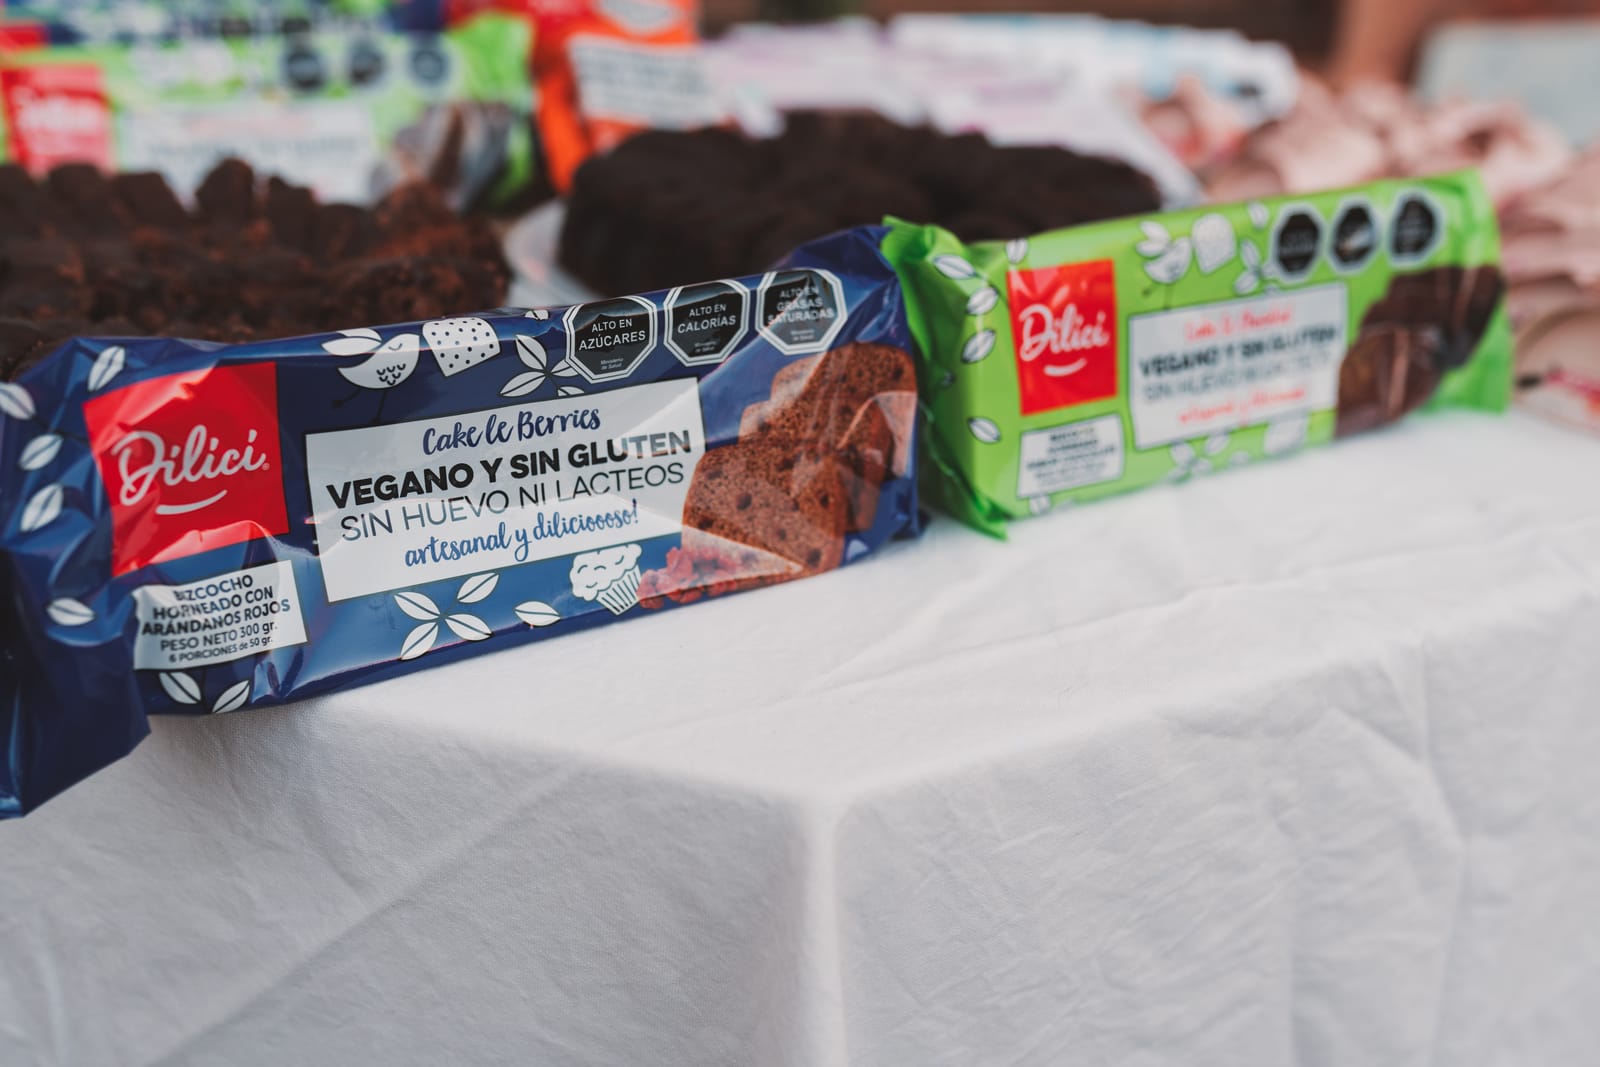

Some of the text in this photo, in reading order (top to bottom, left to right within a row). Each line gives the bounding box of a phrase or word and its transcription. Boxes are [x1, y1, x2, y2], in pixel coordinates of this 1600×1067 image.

[780, 286, 819, 298] ALTO EN
[591, 318, 633, 333] ALTO EN
[677, 314, 736, 334] CALORÍAS
[689, 304, 726, 317] ALTO EN
[578, 331, 646, 351] AZÚCARES
[1019, 303, 1109, 361] Dilici
[422, 408, 601, 455] Cake le Berries
[111, 425, 266, 505] Dilici
[326, 430, 691, 509] VEGANO Y SIN GLUTEN
[340, 462, 684, 541] SIN HUEVO NI LACTEOS
[405, 521, 512, 567] artesanal
[513, 528, 532, 562] y
[153, 586, 274, 620] HORNEADO CON
[173, 574, 253, 601] BIZCOCHO
[142, 598, 291, 636] ARÁNDANOS ROJOS
[160, 637, 199, 652] PESO
[203, 629, 238, 647] NETO
[239, 623, 260, 638] 300
[178, 644, 238, 662] PORCIONES
[239, 642, 248, 651] de
[249, 638, 260, 648] 50
